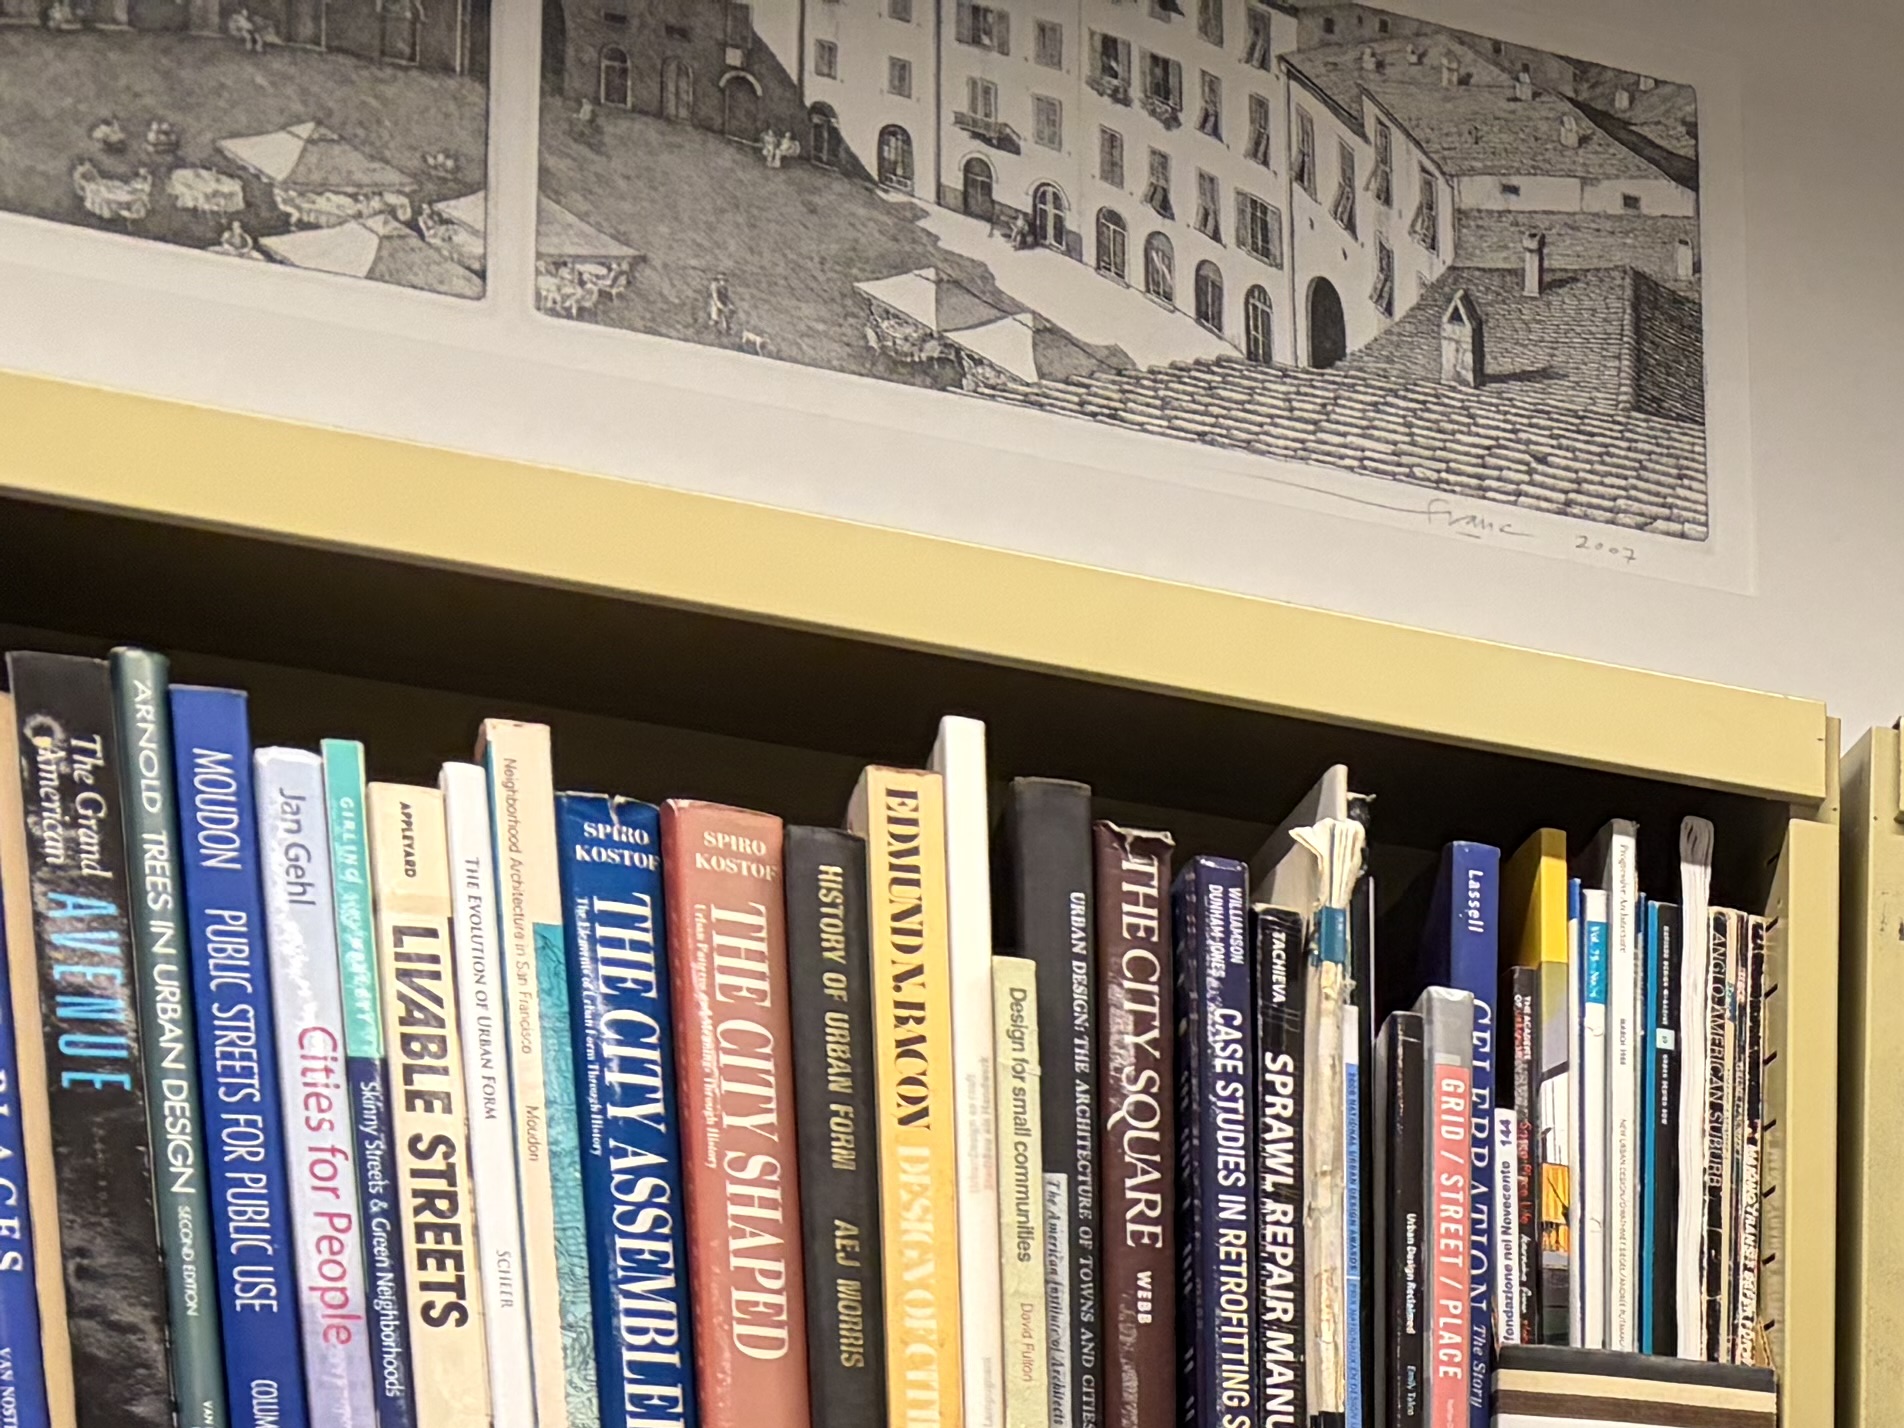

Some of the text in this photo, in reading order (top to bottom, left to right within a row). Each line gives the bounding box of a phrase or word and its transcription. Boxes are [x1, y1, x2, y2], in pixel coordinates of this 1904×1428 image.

[47, 892, 130, 1092] AVENUE
[131, 680, 195, 1194] ARNOLD TREES IN URBAN DESIGN
[593, 892, 656, 1003] THE
[295, 1025, 363, 1349] Cities for People
[390, 924, 469, 1330] LIVABLE STREETS
[602, 1010, 664, 1142] CITY
